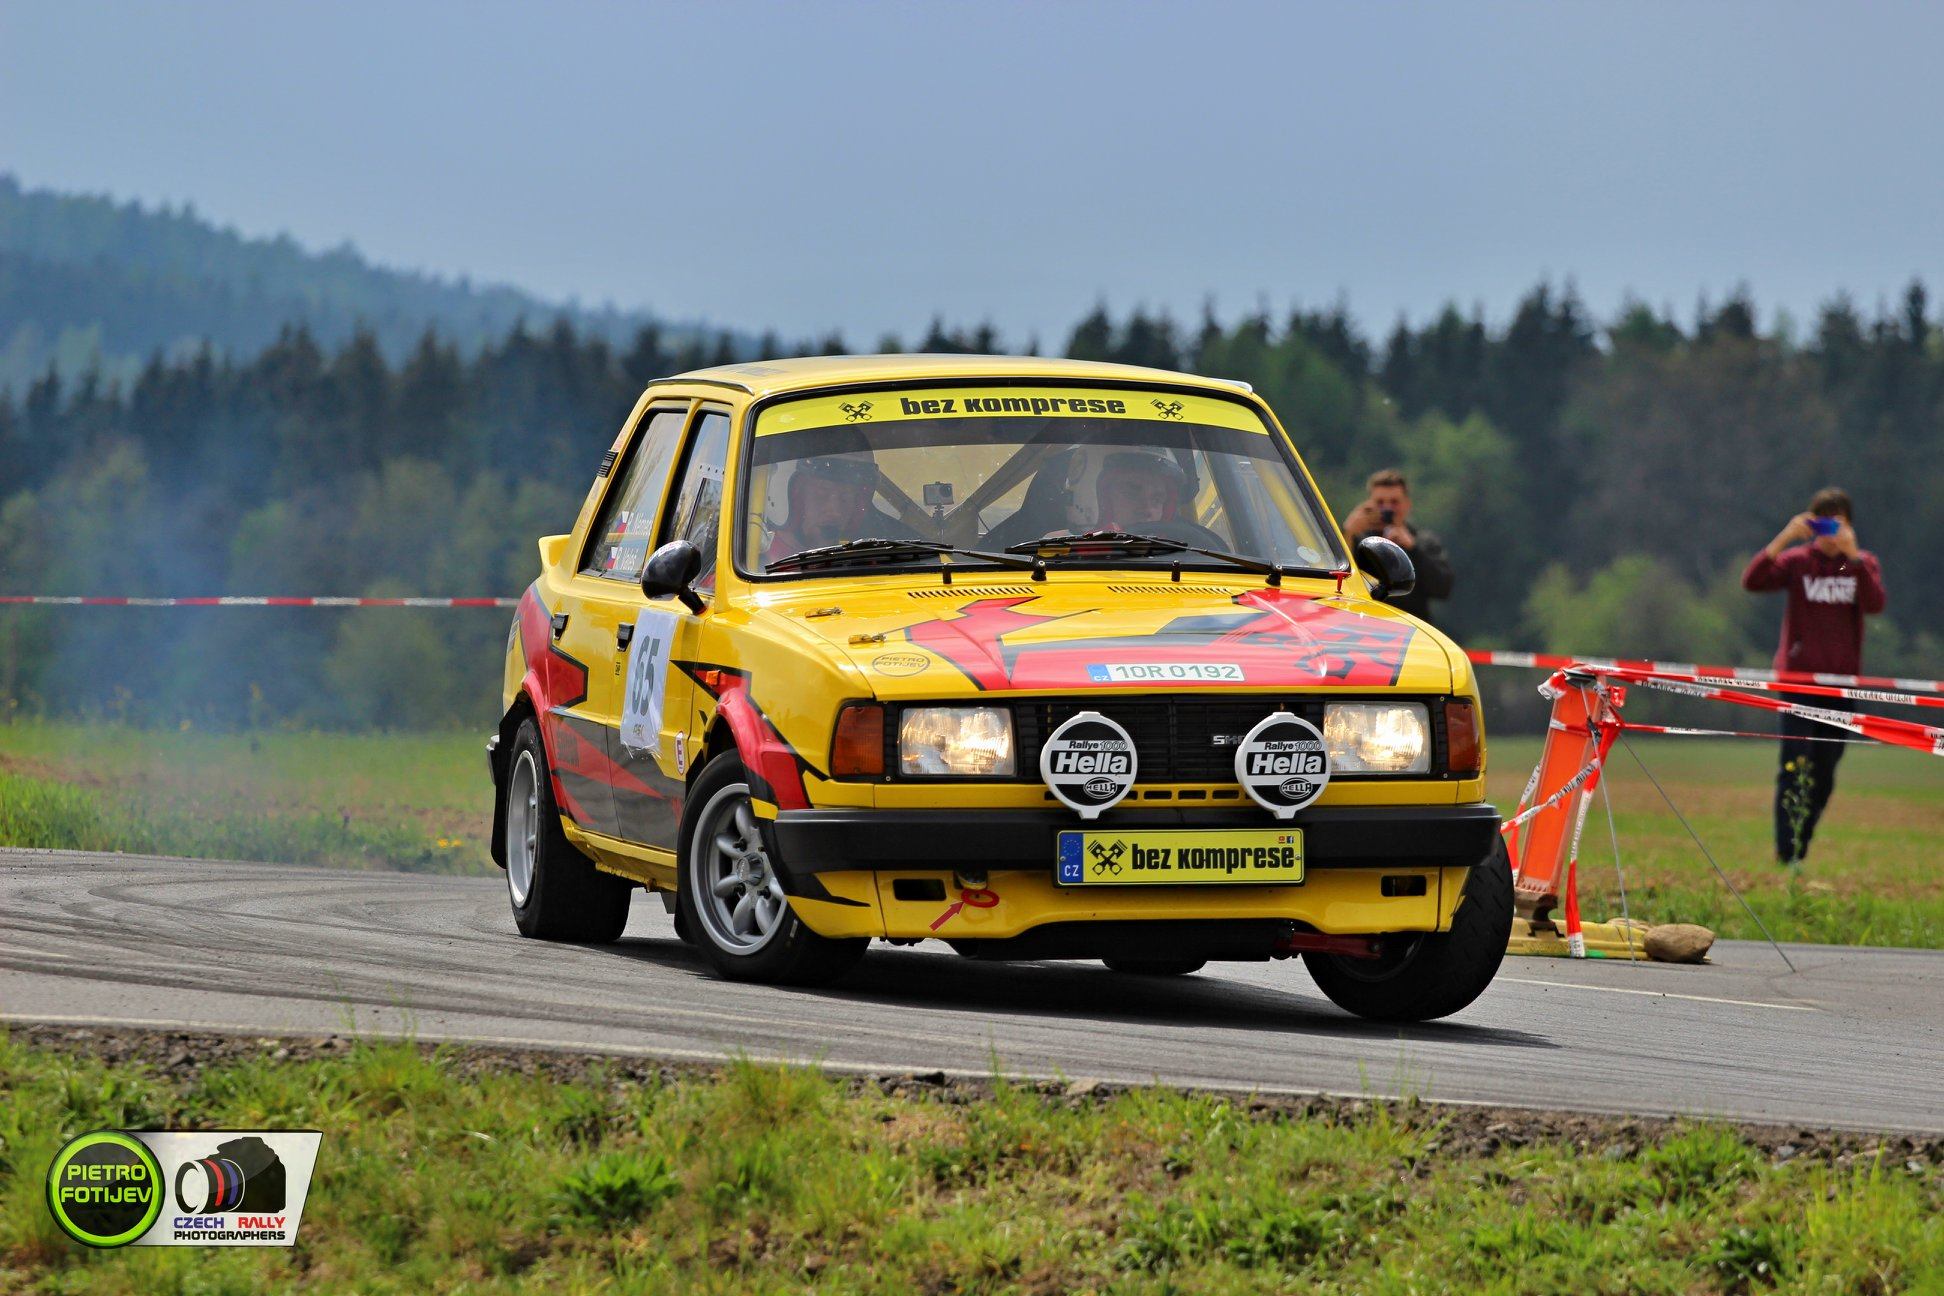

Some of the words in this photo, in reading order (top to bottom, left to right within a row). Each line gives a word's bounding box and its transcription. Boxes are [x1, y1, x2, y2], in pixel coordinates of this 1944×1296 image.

[900, 397, 957, 415] bez
[963, 397, 1126, 415] komprese
[631, 634, 661, 717] 65
[1115, 665, 1164, 679] 10R
[1168, 665, 1240, 679] 0192
[1069, 740, 1099, 750] Rallye
[1099, 740, 1128, 751] 1000
[1264, 741, 1293, 751] Rallye
[1294, 740, 1323, 751] 1000
[1055, 752, 1128, 773] Hella
[1251, 753, 1322, 774] Hella
[1086, 782, 1117, 792] HELLA
[1282, 783, 1312, 792] HELLA
[1131, 844, 1171, 870] bez
[1178, 845, 1294, 875] komprese
[1064, 864, 1079, 877] CZ
